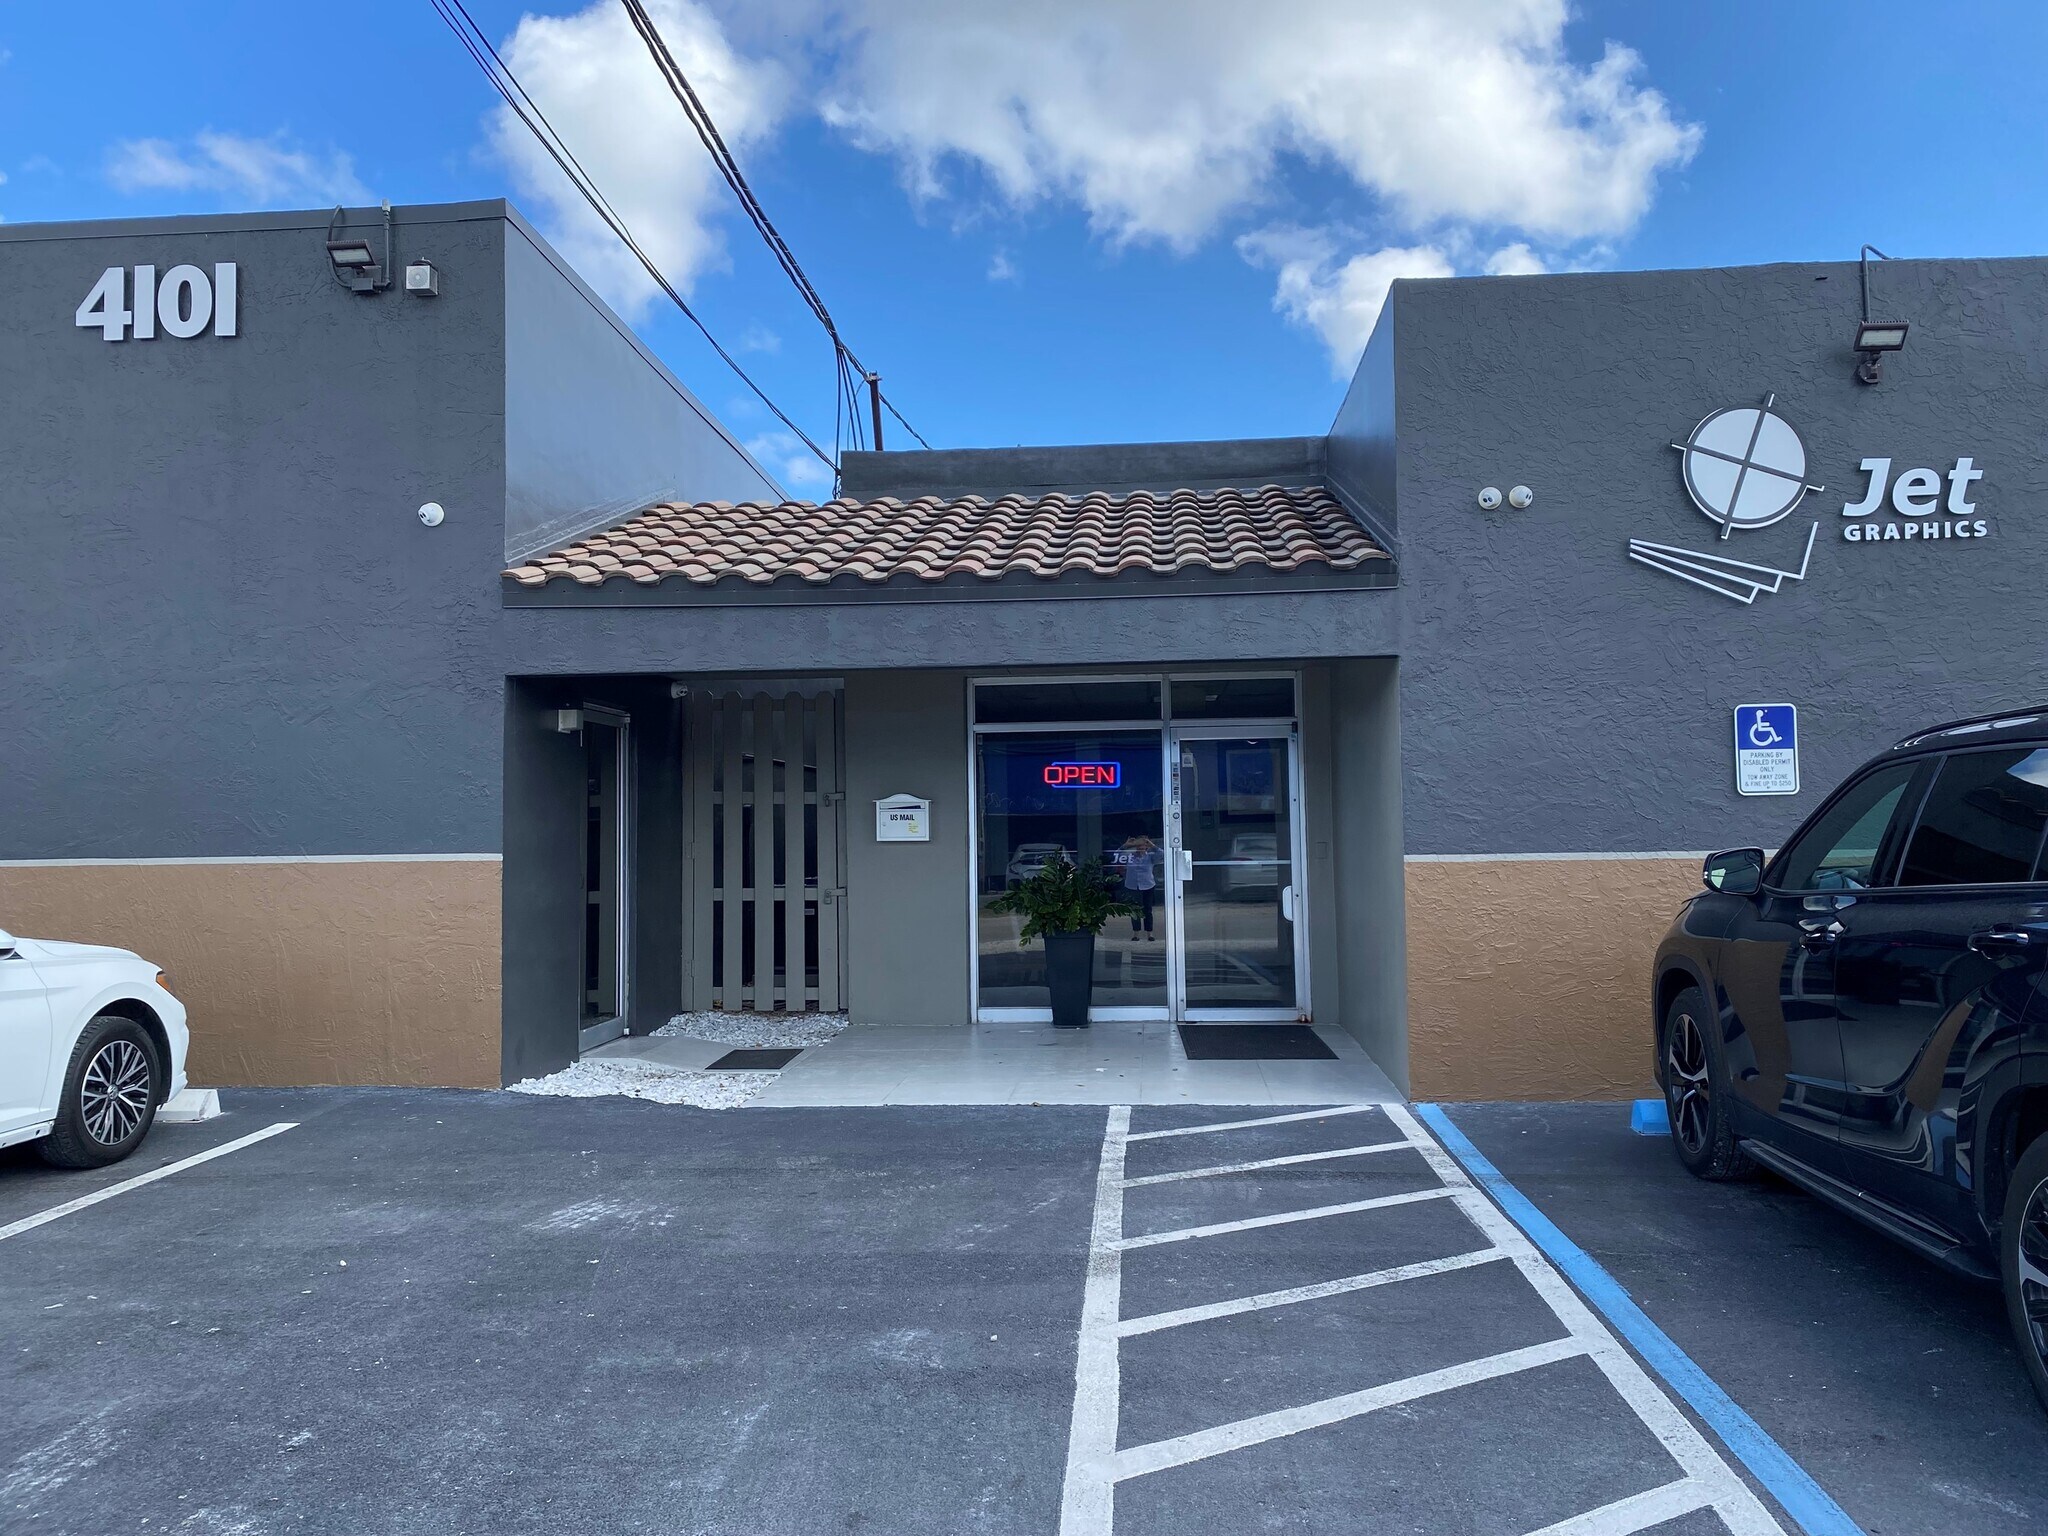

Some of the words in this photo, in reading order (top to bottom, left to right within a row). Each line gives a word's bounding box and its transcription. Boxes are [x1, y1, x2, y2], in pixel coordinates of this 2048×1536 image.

[75, 262, 237, 341] 4101
[1842, 457, 1984, 517] Jet
[1844, 519, 1988, 542] GRAPHICS
[1044, 766, 1114, 784] OPEN
[1778, 779, 1792, 787] $250
[1110, 852, 1135, 864] Jet
